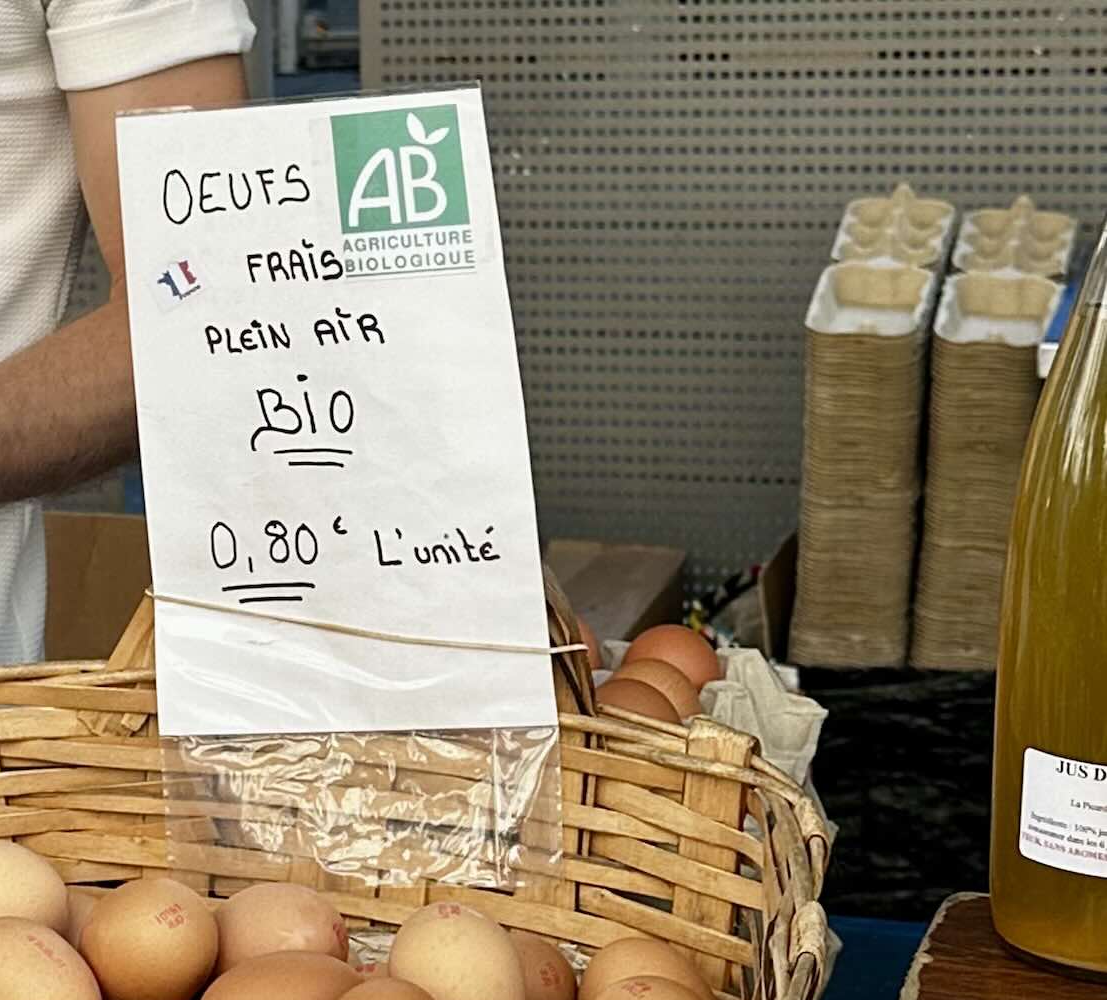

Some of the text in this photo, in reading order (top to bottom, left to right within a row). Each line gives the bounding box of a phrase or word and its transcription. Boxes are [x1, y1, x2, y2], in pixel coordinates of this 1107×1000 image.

[163, 164, 310, 224] OEUFS
[349, 143, 447, 227] AB
[342, 230, 473, 253] AGRICULTURE
[345, 250, 475, 273] BIOLOGIQUE
[373, 526, 501, 567] L'unité
[1056, 760, 1089, 779] JUS
